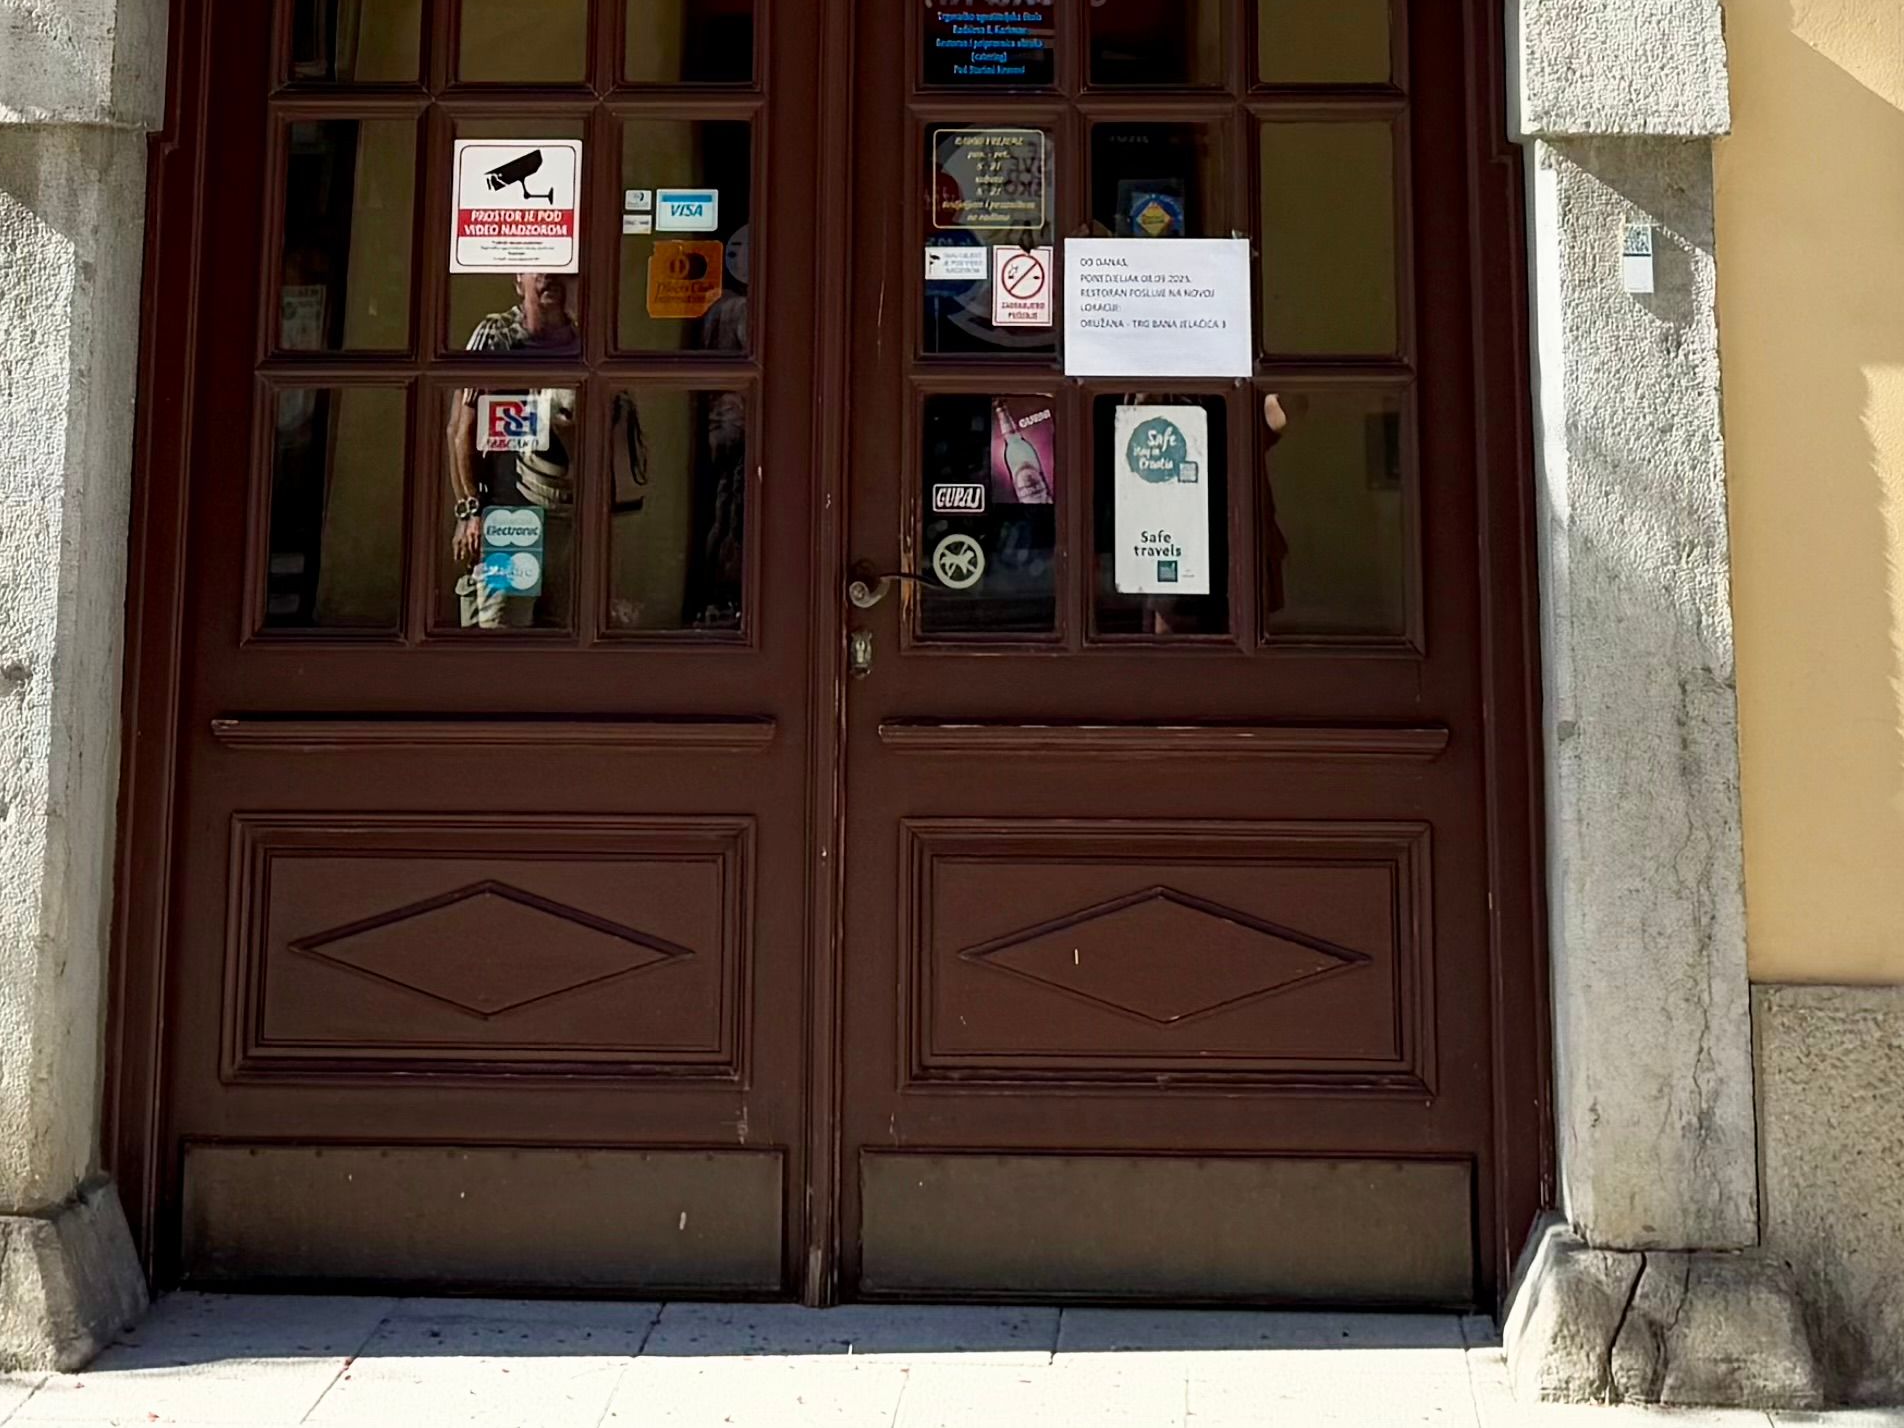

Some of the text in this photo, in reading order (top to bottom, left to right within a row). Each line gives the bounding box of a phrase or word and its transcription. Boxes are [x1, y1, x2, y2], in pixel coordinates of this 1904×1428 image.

[471, 210, 522, 222] PROSTOR
[537, 209, 562, 222] POD
[671, 203, 703, 217] VISA
[464, 224, 568, 235] VIDEO NADZOROM
[1146, 426, 1178, 452] Safe
[1140, 529, 1172, 544] Safe
[1133, 543, 1182, 557] travels
